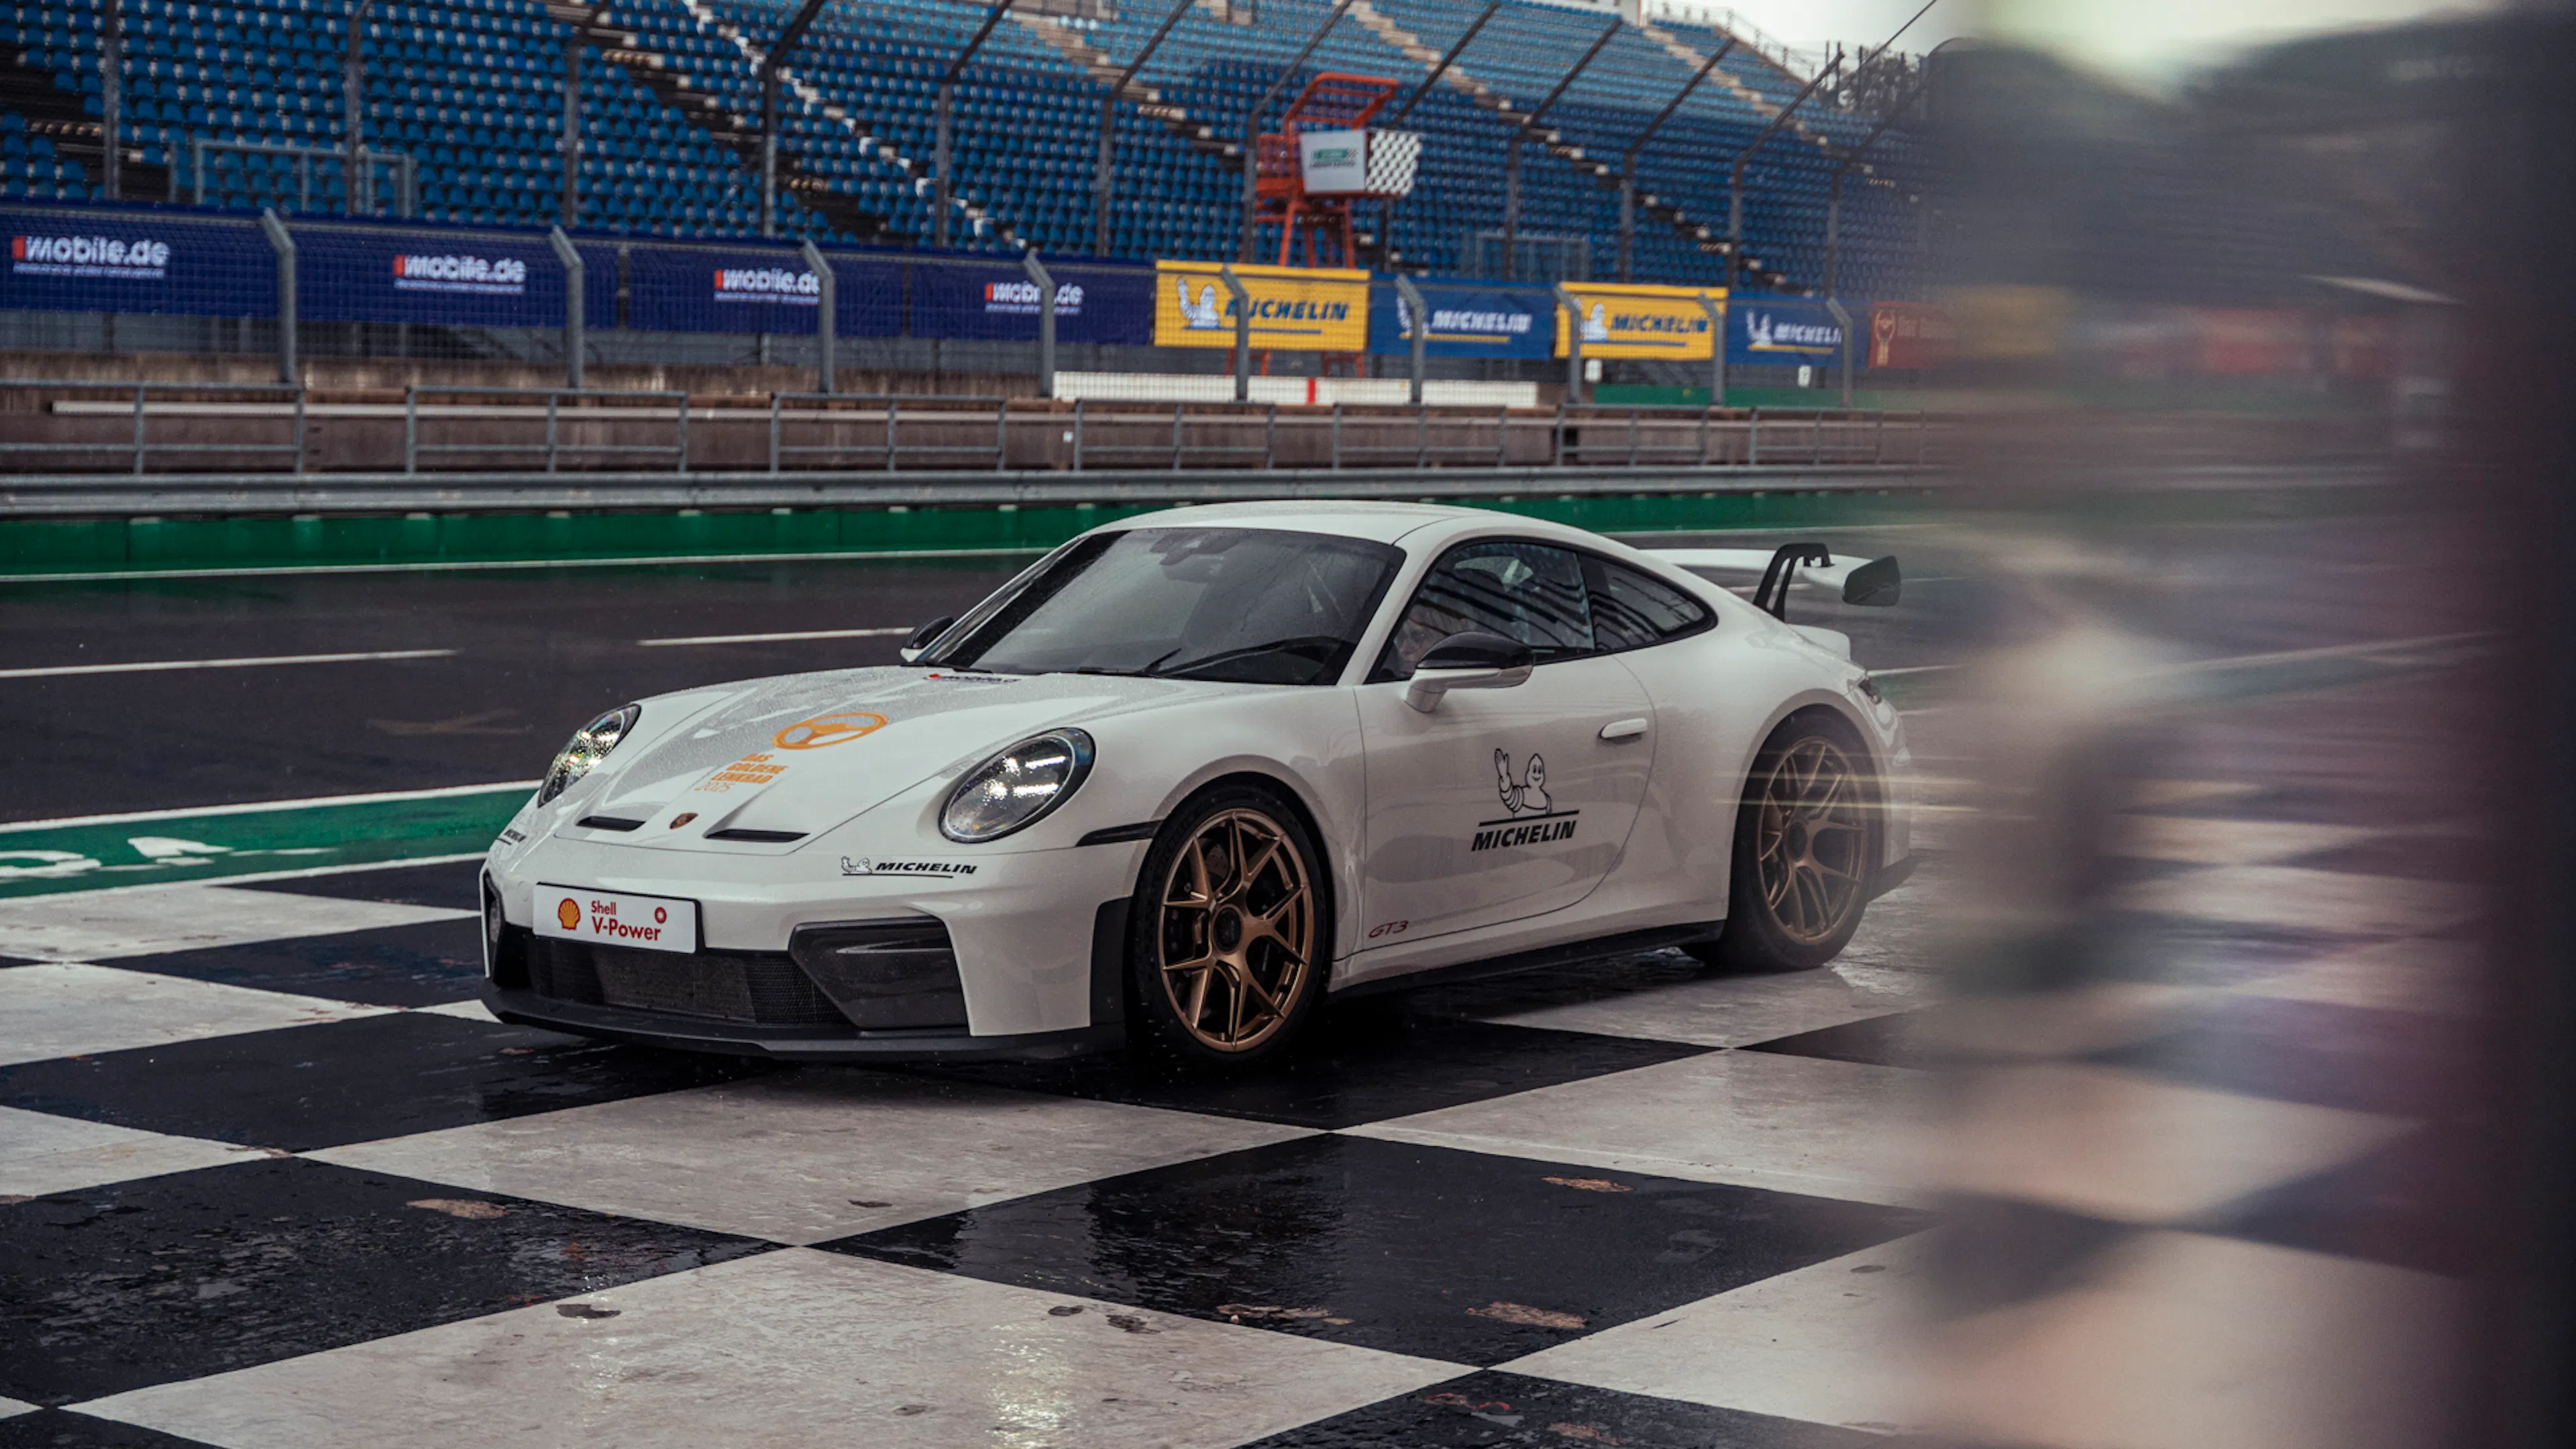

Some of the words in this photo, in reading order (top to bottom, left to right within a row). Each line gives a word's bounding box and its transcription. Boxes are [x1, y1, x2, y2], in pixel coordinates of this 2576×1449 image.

[25, 235, 170, 266] mobile.de
[405, 254, 525, 282] mobile.de
[1432, 311, 1533, 333] MICHELIN
[1611, 313, 1709, 333] MICHELIN
[710, 772, 774, 784] LENKRAD
[1471, 820, 1576, 852] MICHELIN
[875, 863, 978, 875] MICHELIN
[591, 900, 616, 916] Shell
[592, 916, 661, 941] V-Power
[1368, 920, 1409, 938] GT3
